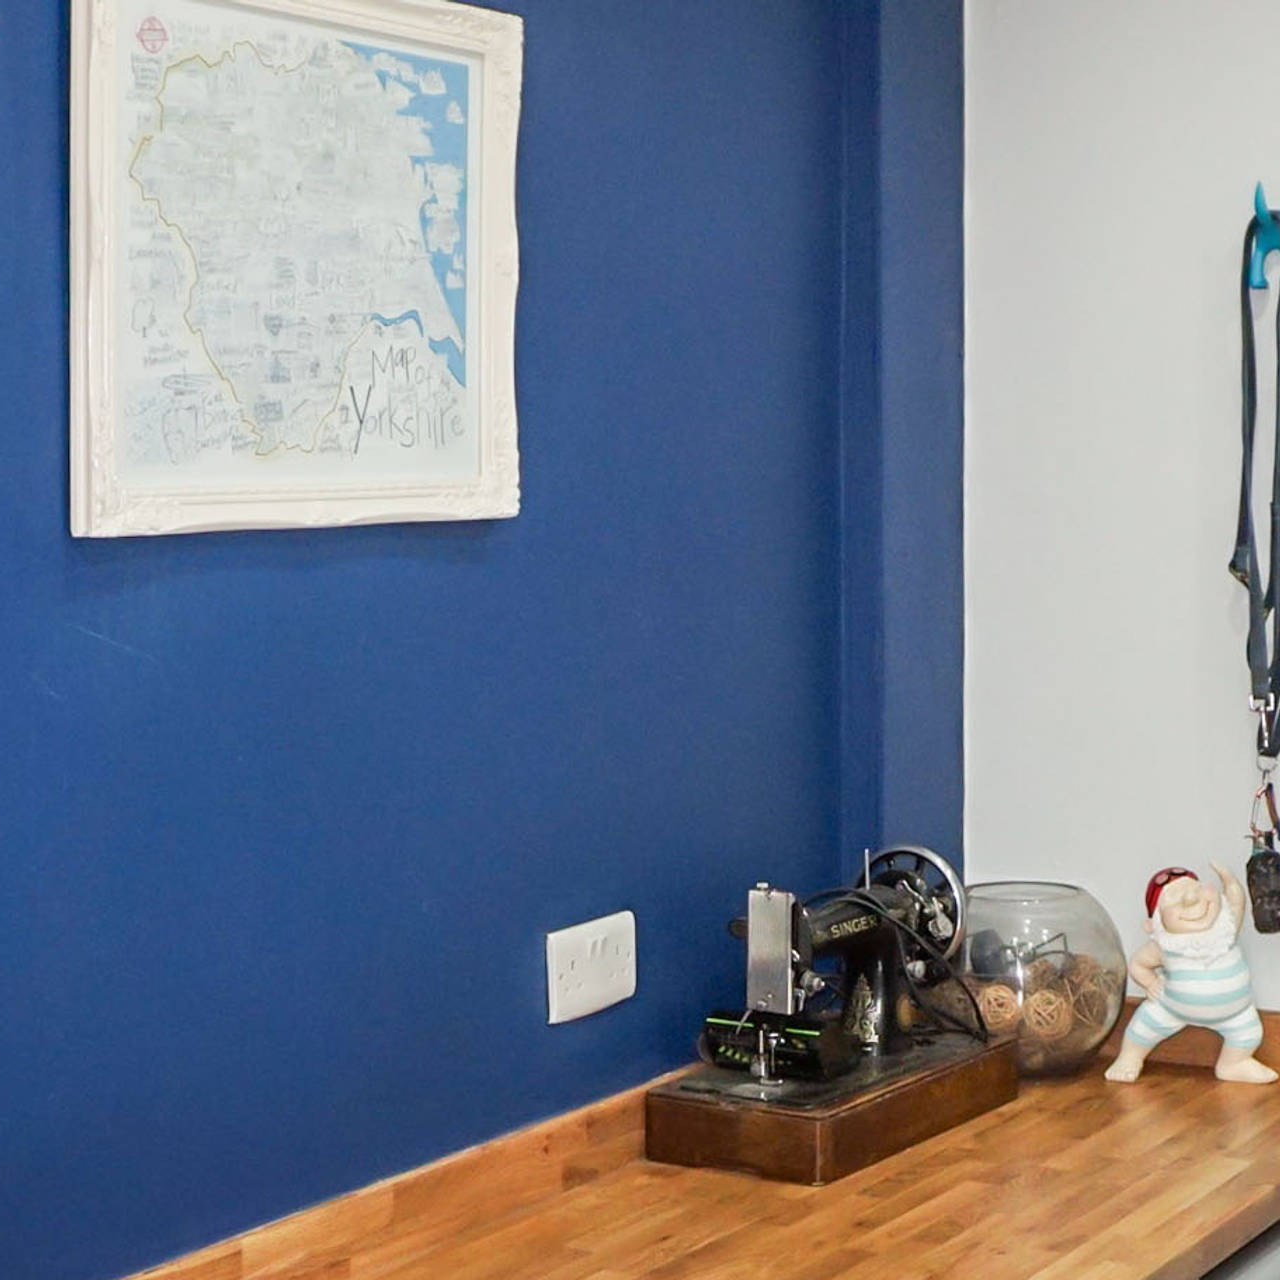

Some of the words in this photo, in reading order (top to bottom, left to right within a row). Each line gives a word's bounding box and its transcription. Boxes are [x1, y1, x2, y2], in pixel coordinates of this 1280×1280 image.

[371, 344, 417, 388] Map
[349, 383, 465, 455] Yorkshire
[830, 914, 878, 939] SINGER
